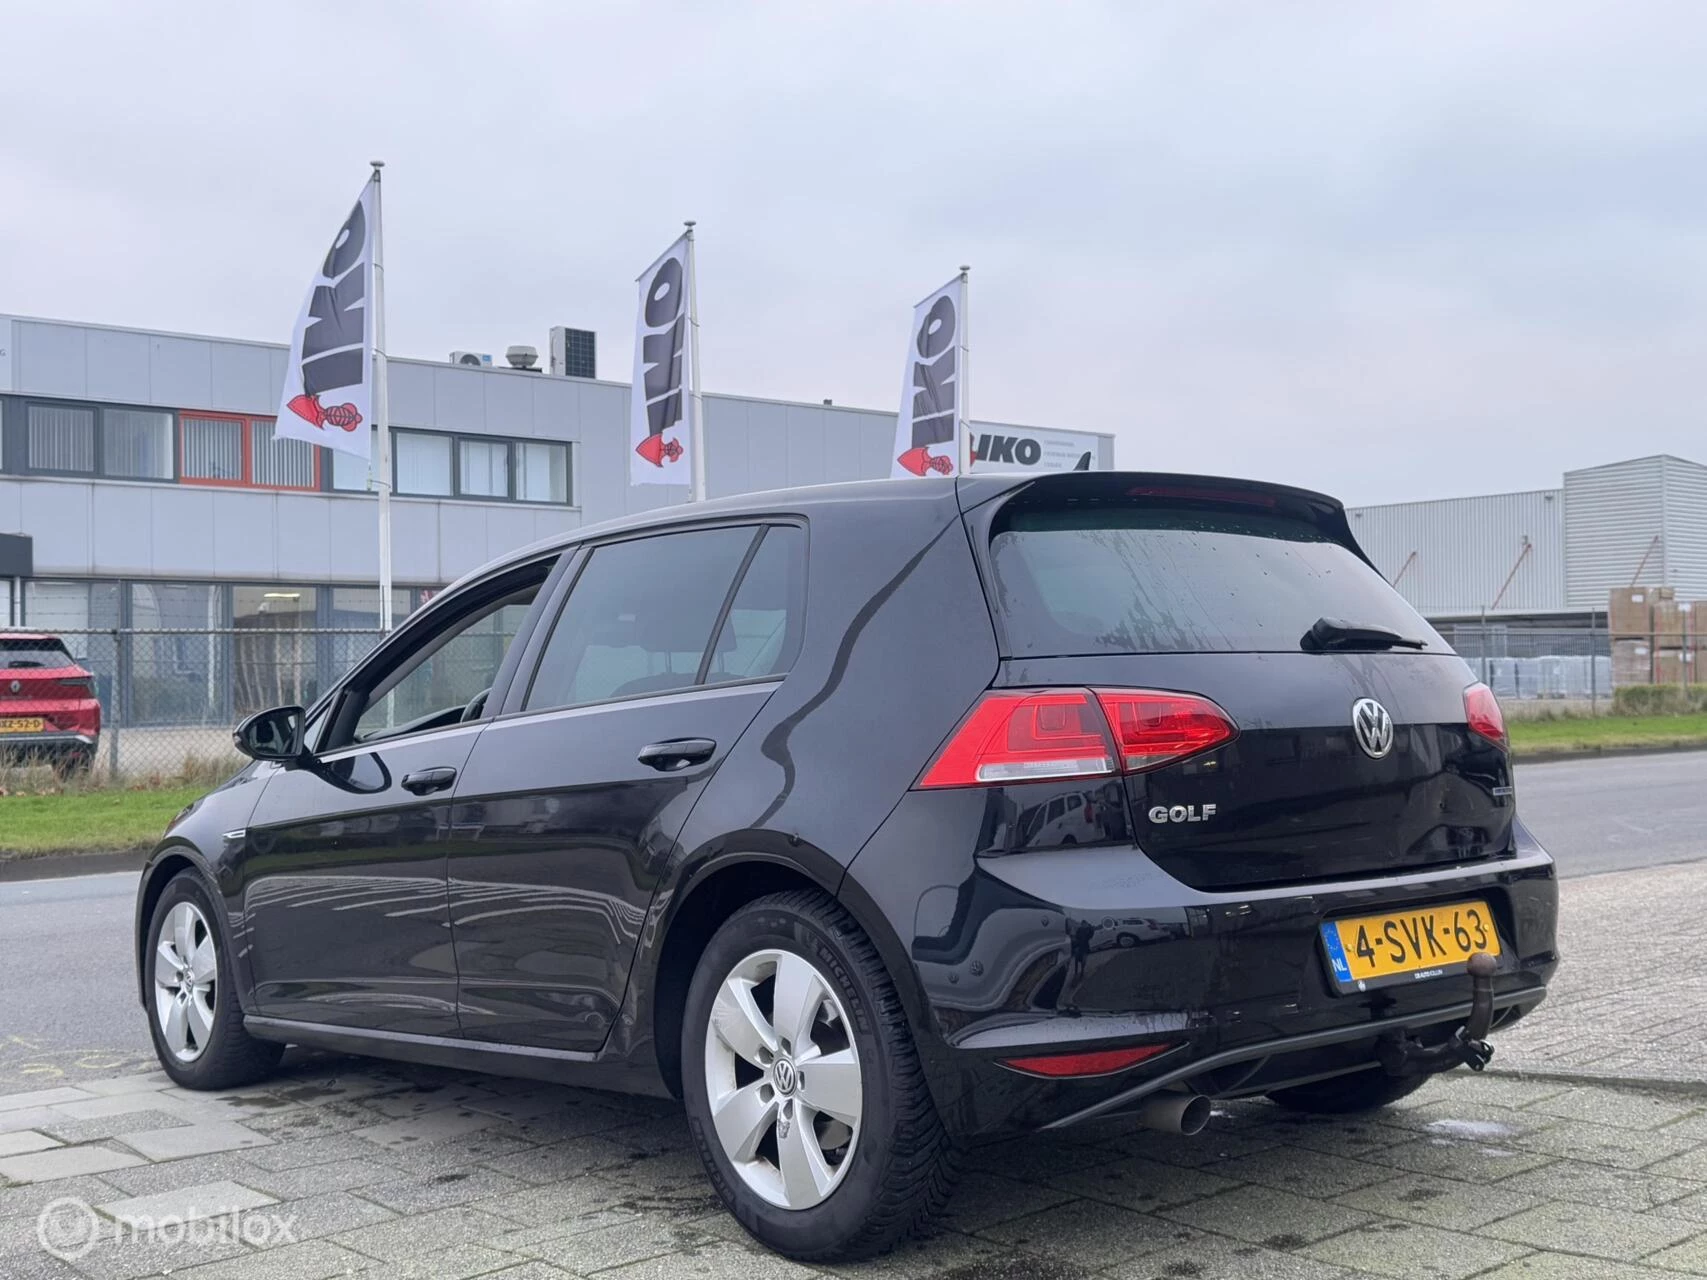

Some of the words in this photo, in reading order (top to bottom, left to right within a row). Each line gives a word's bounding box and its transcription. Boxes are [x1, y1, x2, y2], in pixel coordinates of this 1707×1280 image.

[301, 199, 366, 397] IKO
[643, 257, 685, 438] IKO
[912, 295, 956, 449] IKO
[975, 434, 1042, 466] IKO
[1148, 803, 1217, 824] GOLF
[1332, 958, 1348, 973] NL
[1355, 908, 1488, 968] 4-SVK-63
[819, 946, 870, 1032] MICHELIN
